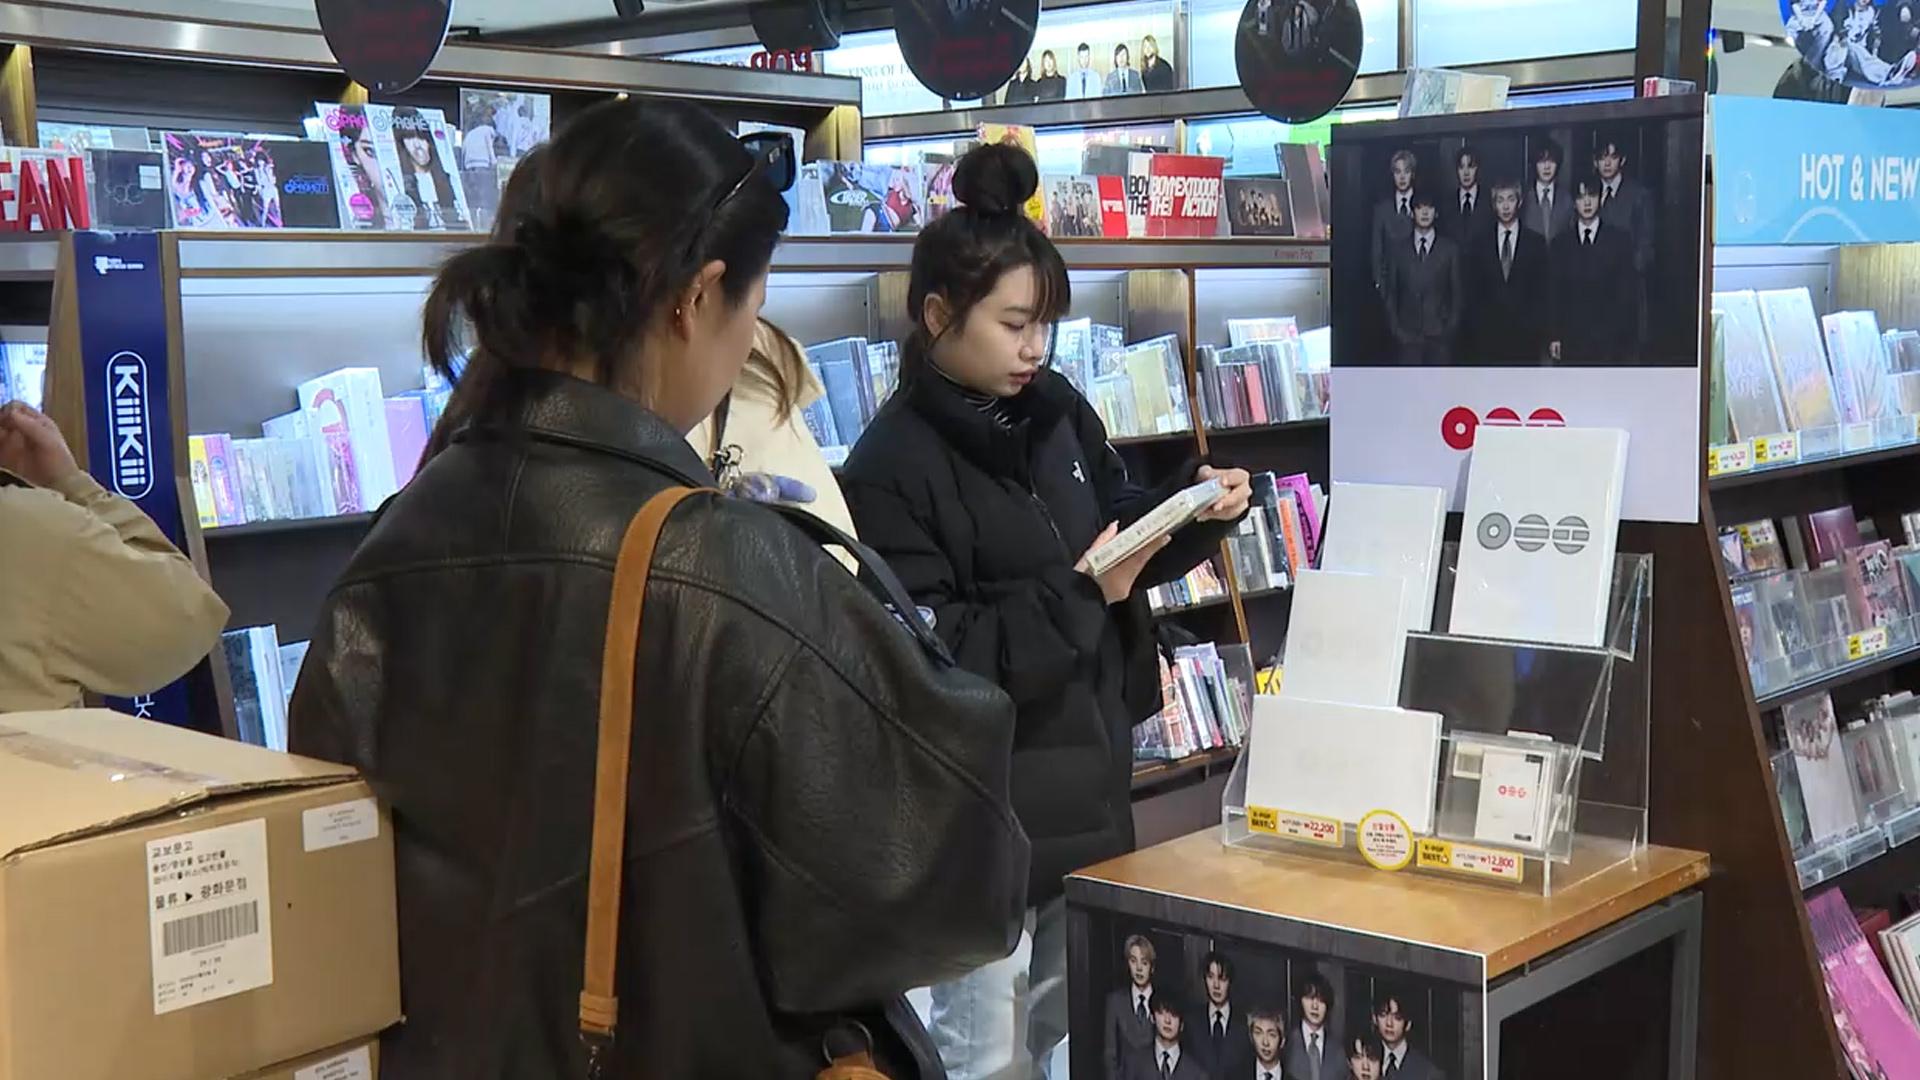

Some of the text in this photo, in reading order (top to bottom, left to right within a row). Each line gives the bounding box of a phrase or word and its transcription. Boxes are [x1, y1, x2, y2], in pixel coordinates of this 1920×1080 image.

[1800, 152, 1920, 201] HOT & NEW
[114, 365, 147, 486] KiiiKiii
[201, 877, 247, 900] 광화문점
